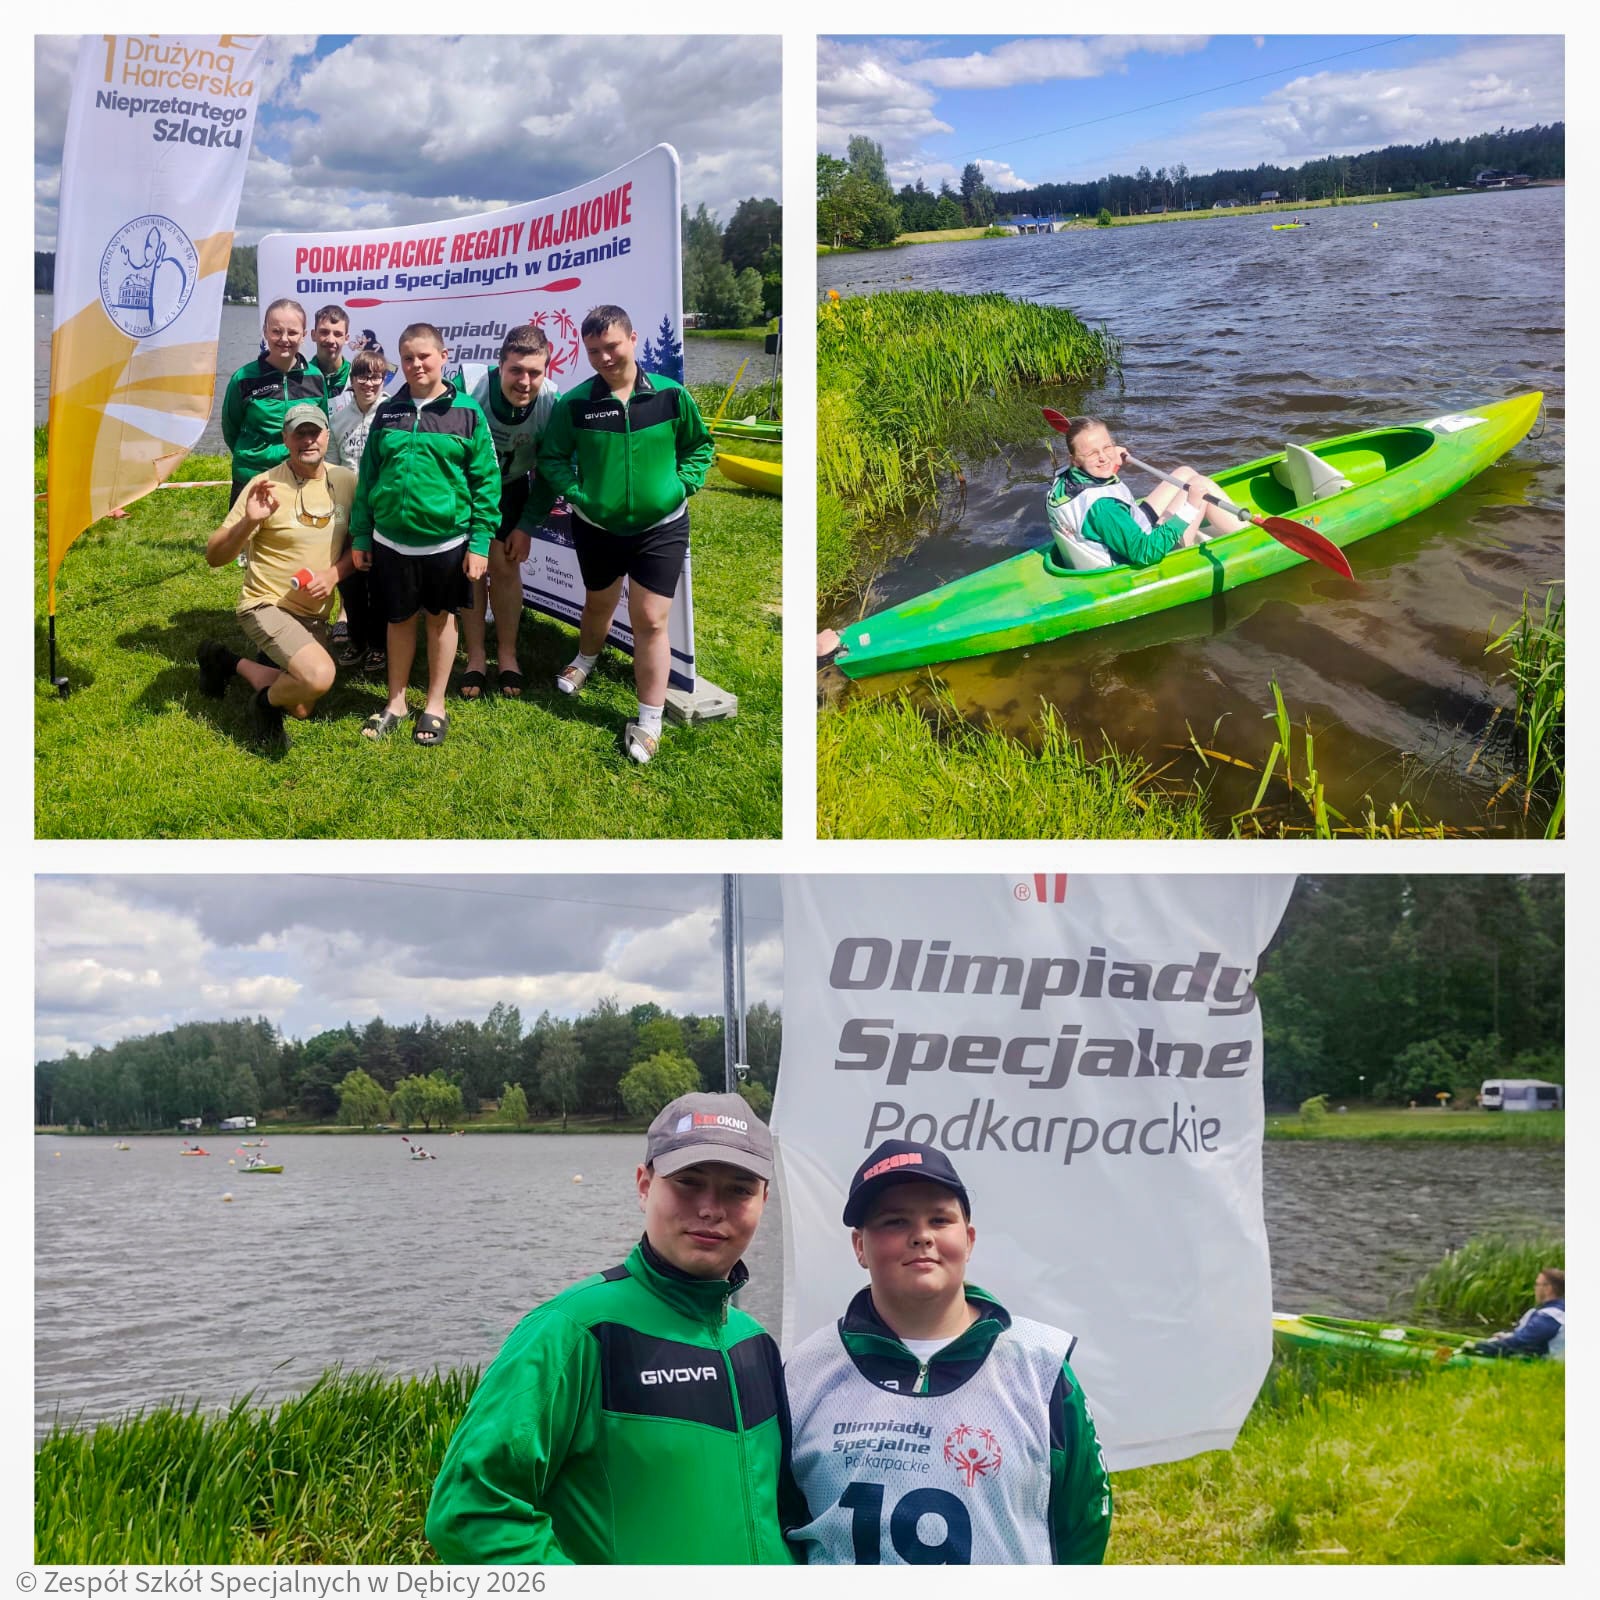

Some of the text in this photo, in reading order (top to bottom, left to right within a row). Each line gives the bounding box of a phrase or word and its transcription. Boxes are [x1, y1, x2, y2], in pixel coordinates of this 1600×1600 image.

[103, 35, 236, 83] 1 Drużyna
[122, 62, 255, 98] Harcerska
[95, 90, 247, 128] Nieprzetartego
[152, 118, 243, 149] Szlaku
[295, 181, 632, 274] PODKARPACKIE REGATY KAJAKOWE
[296, 236, 631, 295] Olimpiad Specjalnych w Ożannie
[436, 320, 507, 341] mpiady
[584, 410, 620, 420] GIVOVA
[545, 555, 559, 566] Moc
[828, 937, 1258, 1016] Olimpiady
[834, 1018, 1253, 1089] Specjalne
[863, 1098, 1221, 1165] Podkarpackie
[640, 1366, 718, 1385] GIVOVA
[832, 1436, 931, 1455] Specjalne
[833, 1420, 934, 1439] Olimpiady
[838, 1481, 973, 1565] 19
